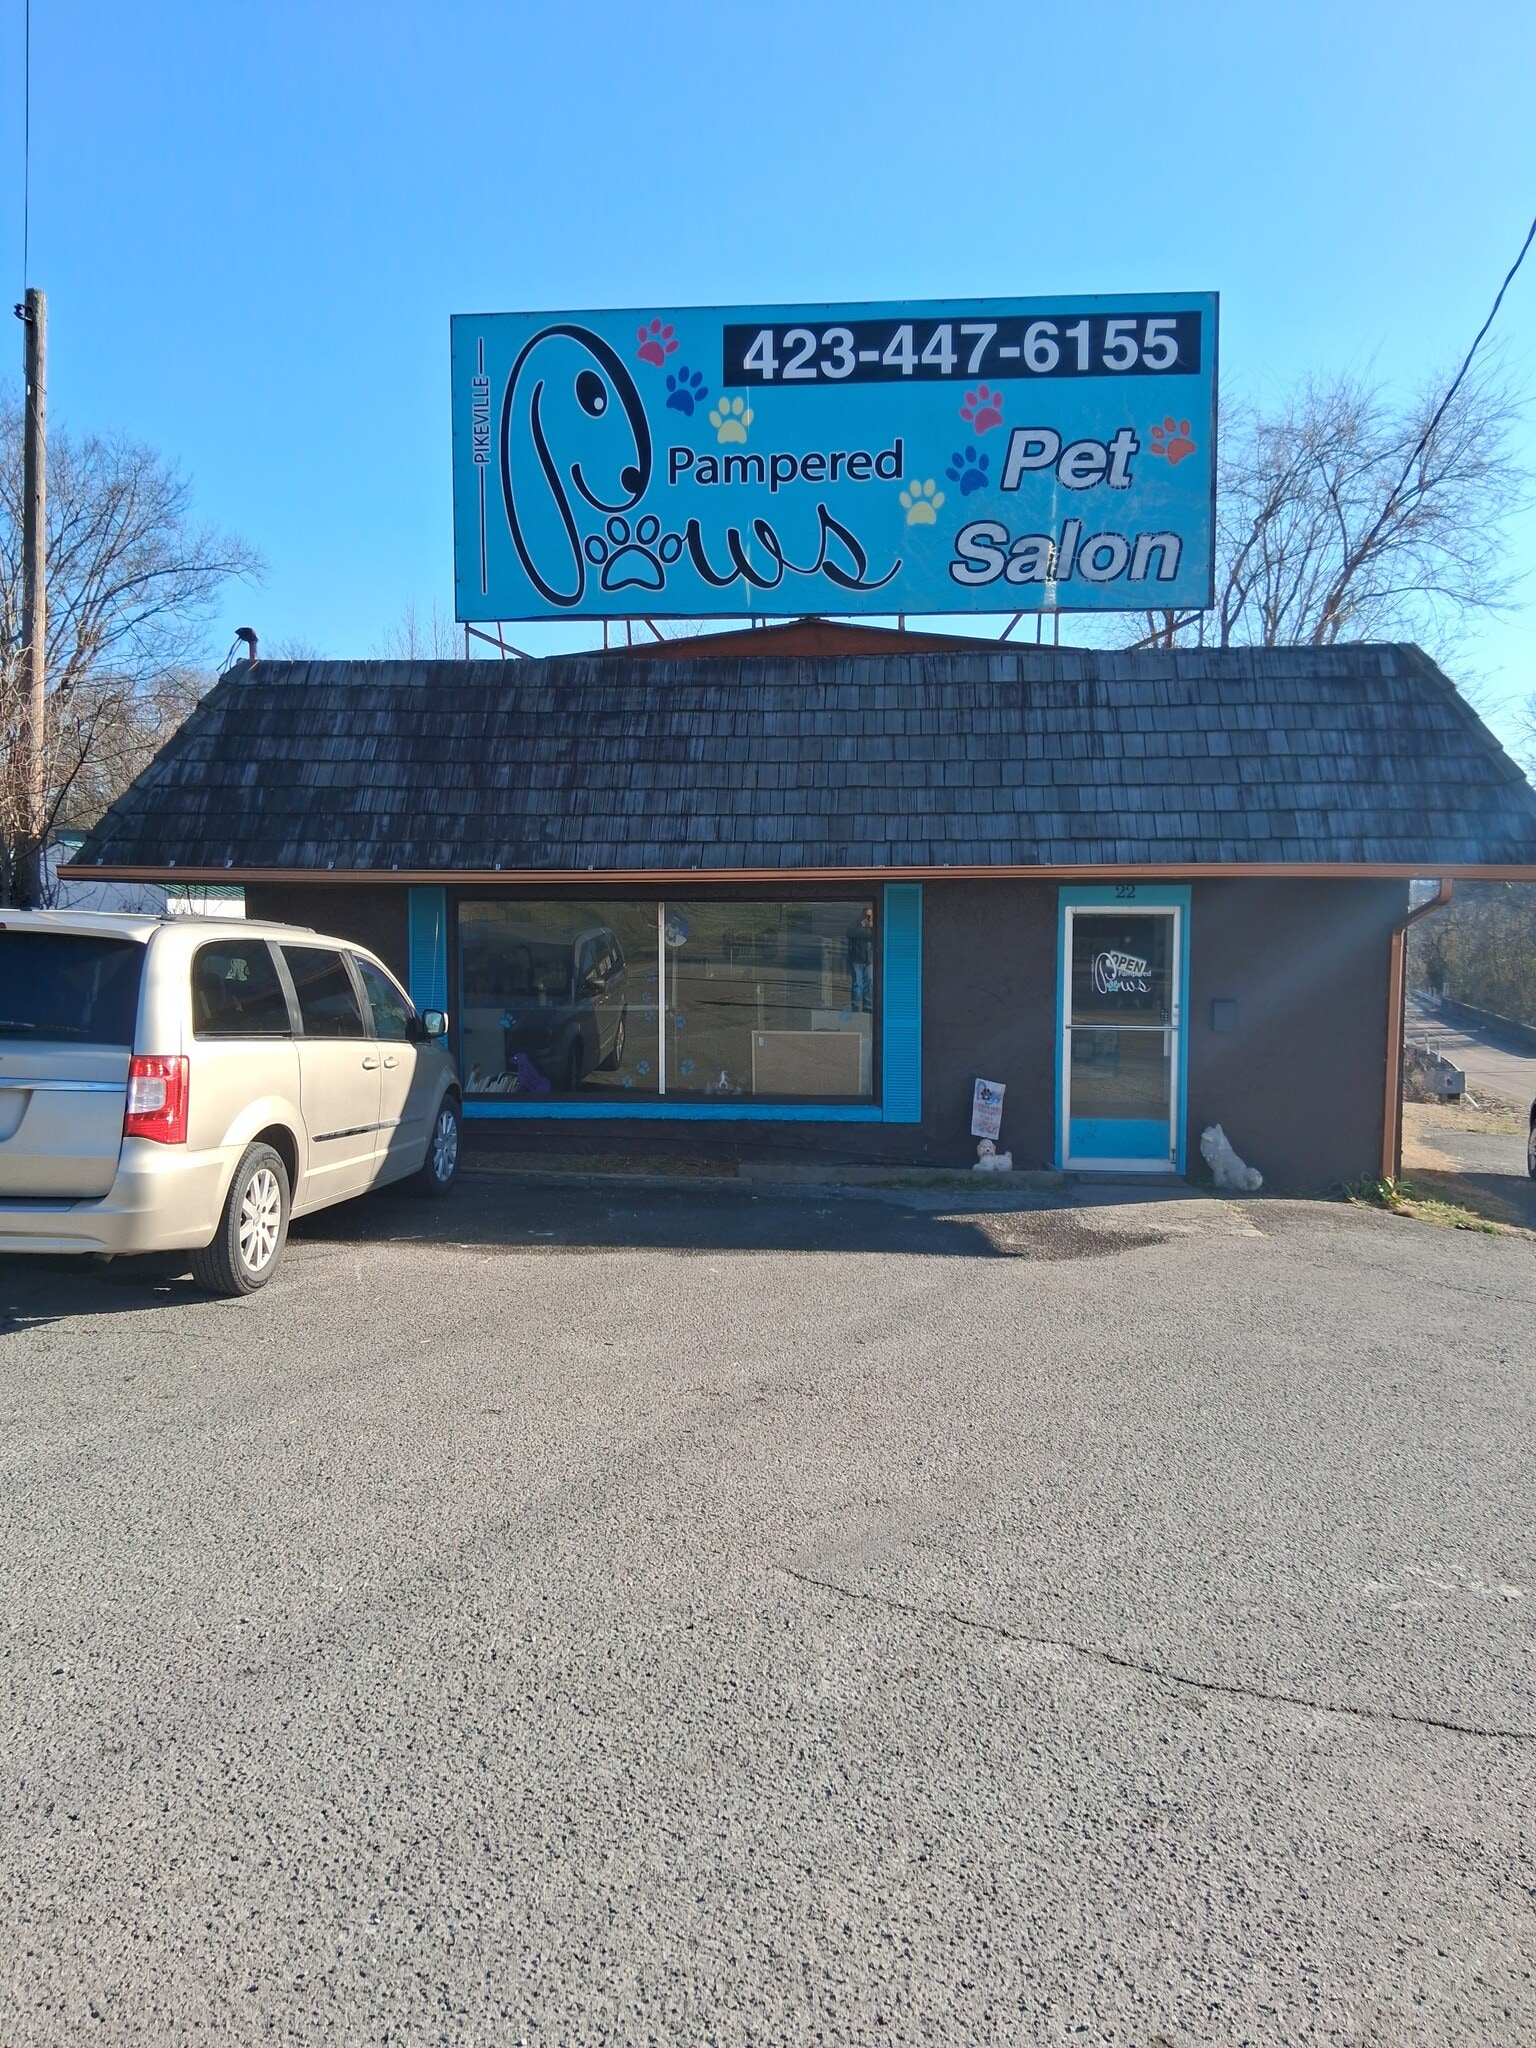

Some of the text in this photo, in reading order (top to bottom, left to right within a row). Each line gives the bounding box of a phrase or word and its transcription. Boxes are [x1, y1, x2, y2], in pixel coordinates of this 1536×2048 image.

[743, 318, 1181, 380] 423-447-6155
[472, 376, 491, 464] PIKEVILLE
[668, 438, 904, 493] Pampered
[1001, 426, 1139, 491] Pet
[948, 517, 1184, 586] Salon
[1115, 884, 1136, 899] 22
[1110, 953, 1145, 973] OPEN
[1118, 969, 1152, 978] Pamped
